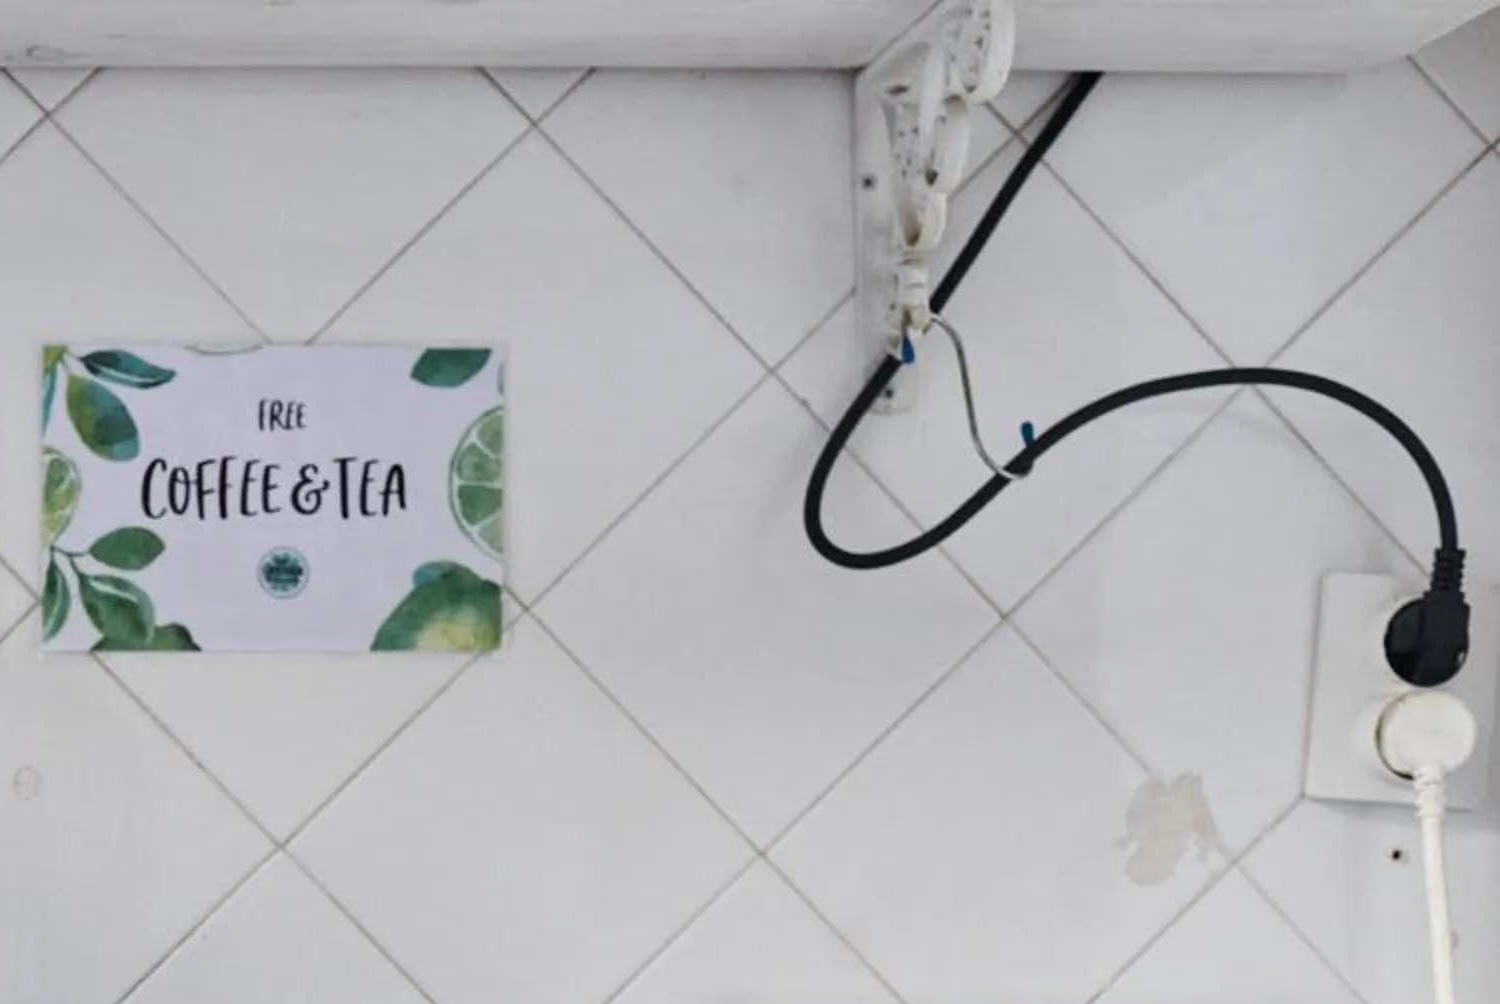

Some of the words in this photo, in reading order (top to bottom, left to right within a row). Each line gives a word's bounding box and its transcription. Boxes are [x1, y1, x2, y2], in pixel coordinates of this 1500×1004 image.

[258, 398, 307, 432] FREE
[141, 456, 282, 520] COFFEE
[291, 463, 330, 515] &
[332, 457, 408, 519] TEA
